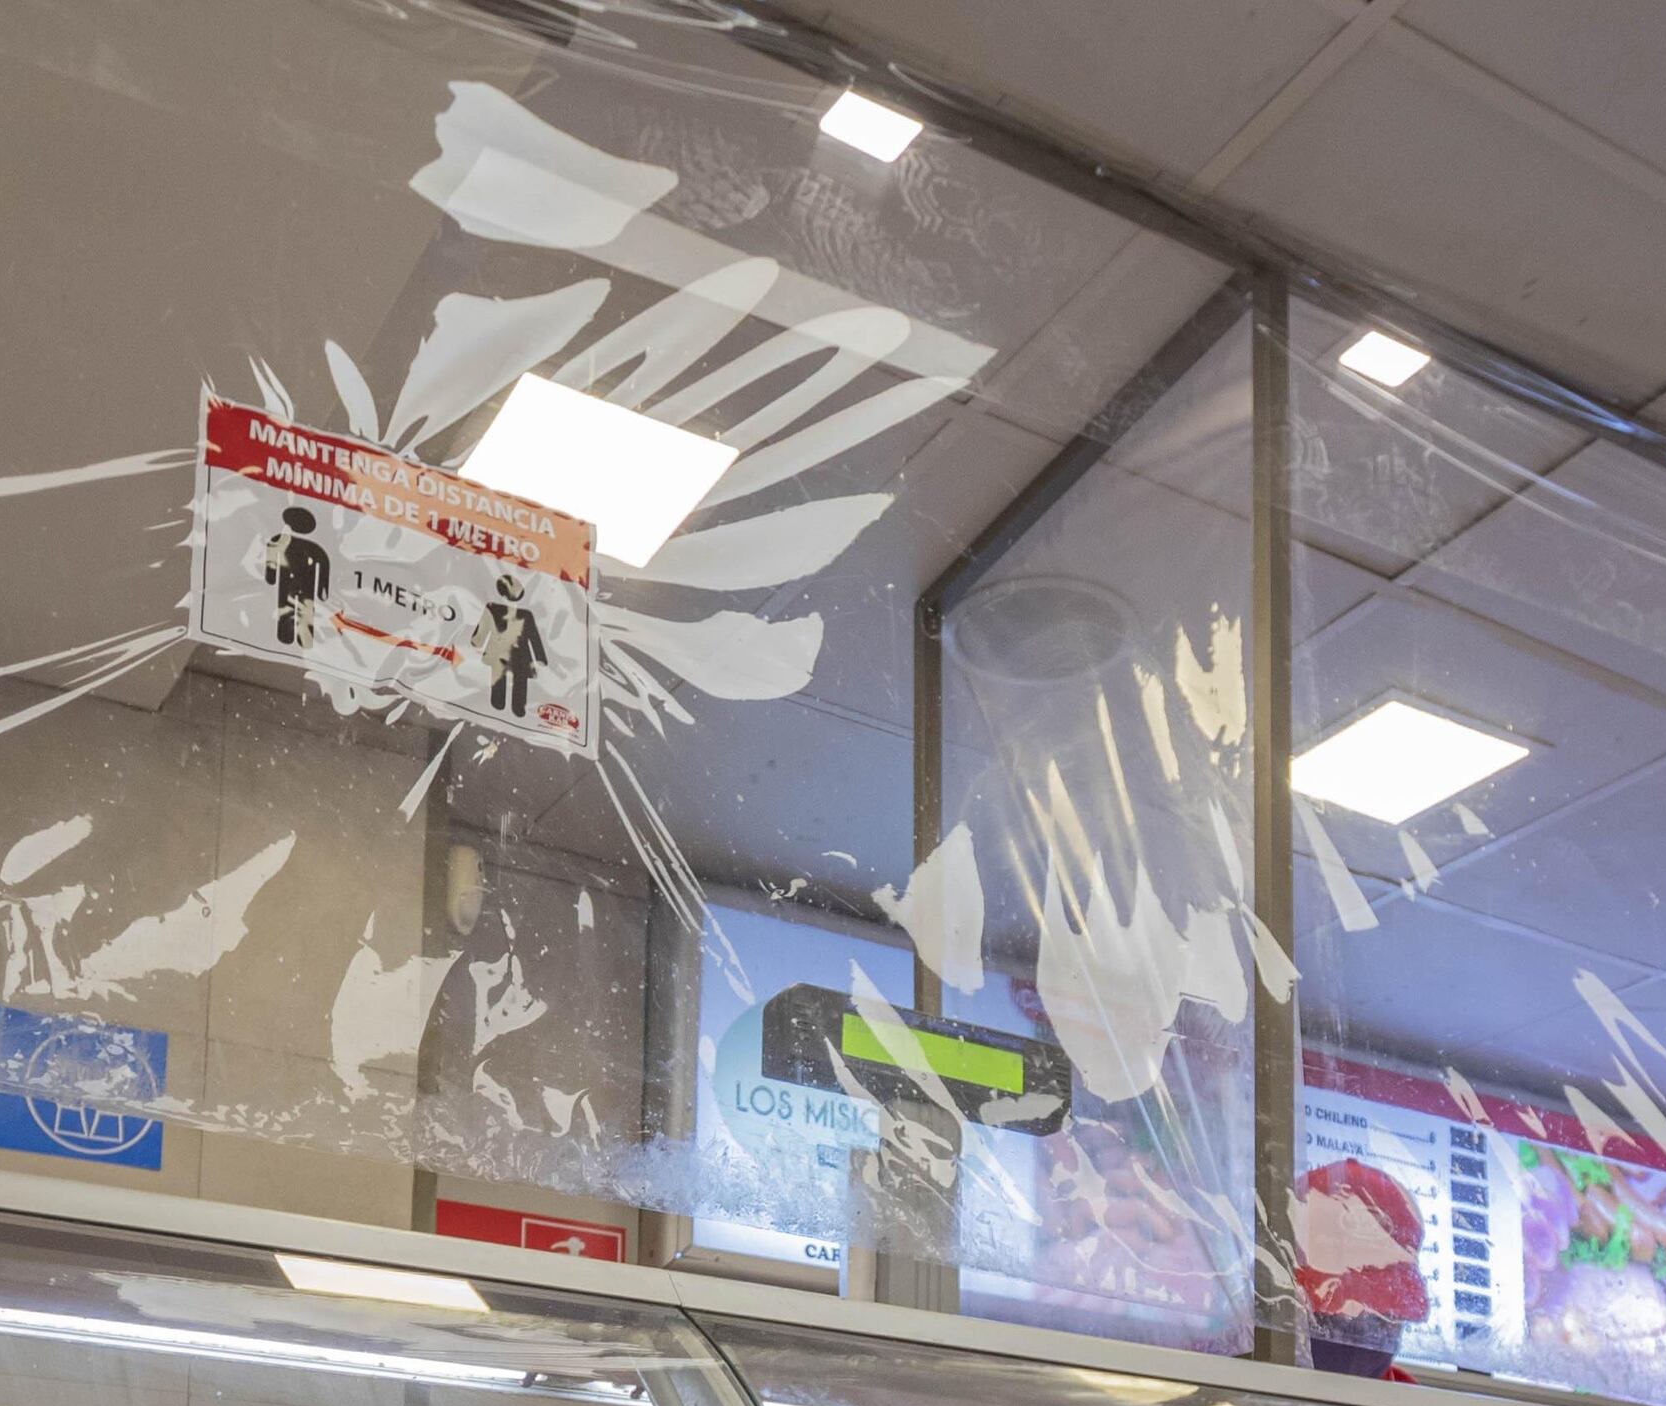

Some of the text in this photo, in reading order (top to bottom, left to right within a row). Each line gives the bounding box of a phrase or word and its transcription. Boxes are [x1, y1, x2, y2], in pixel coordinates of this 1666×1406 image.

[249, 419, 556, 539] MANTENGA DISTANCIA
[265, 456, 541, 562] MÍNIMA DE 1 METRO
[353, 571, 457, 622] 1 METRO
[736, 1080, 793, 1120] LOS
[1316, 1107, 1368, 1129] CHILENO
